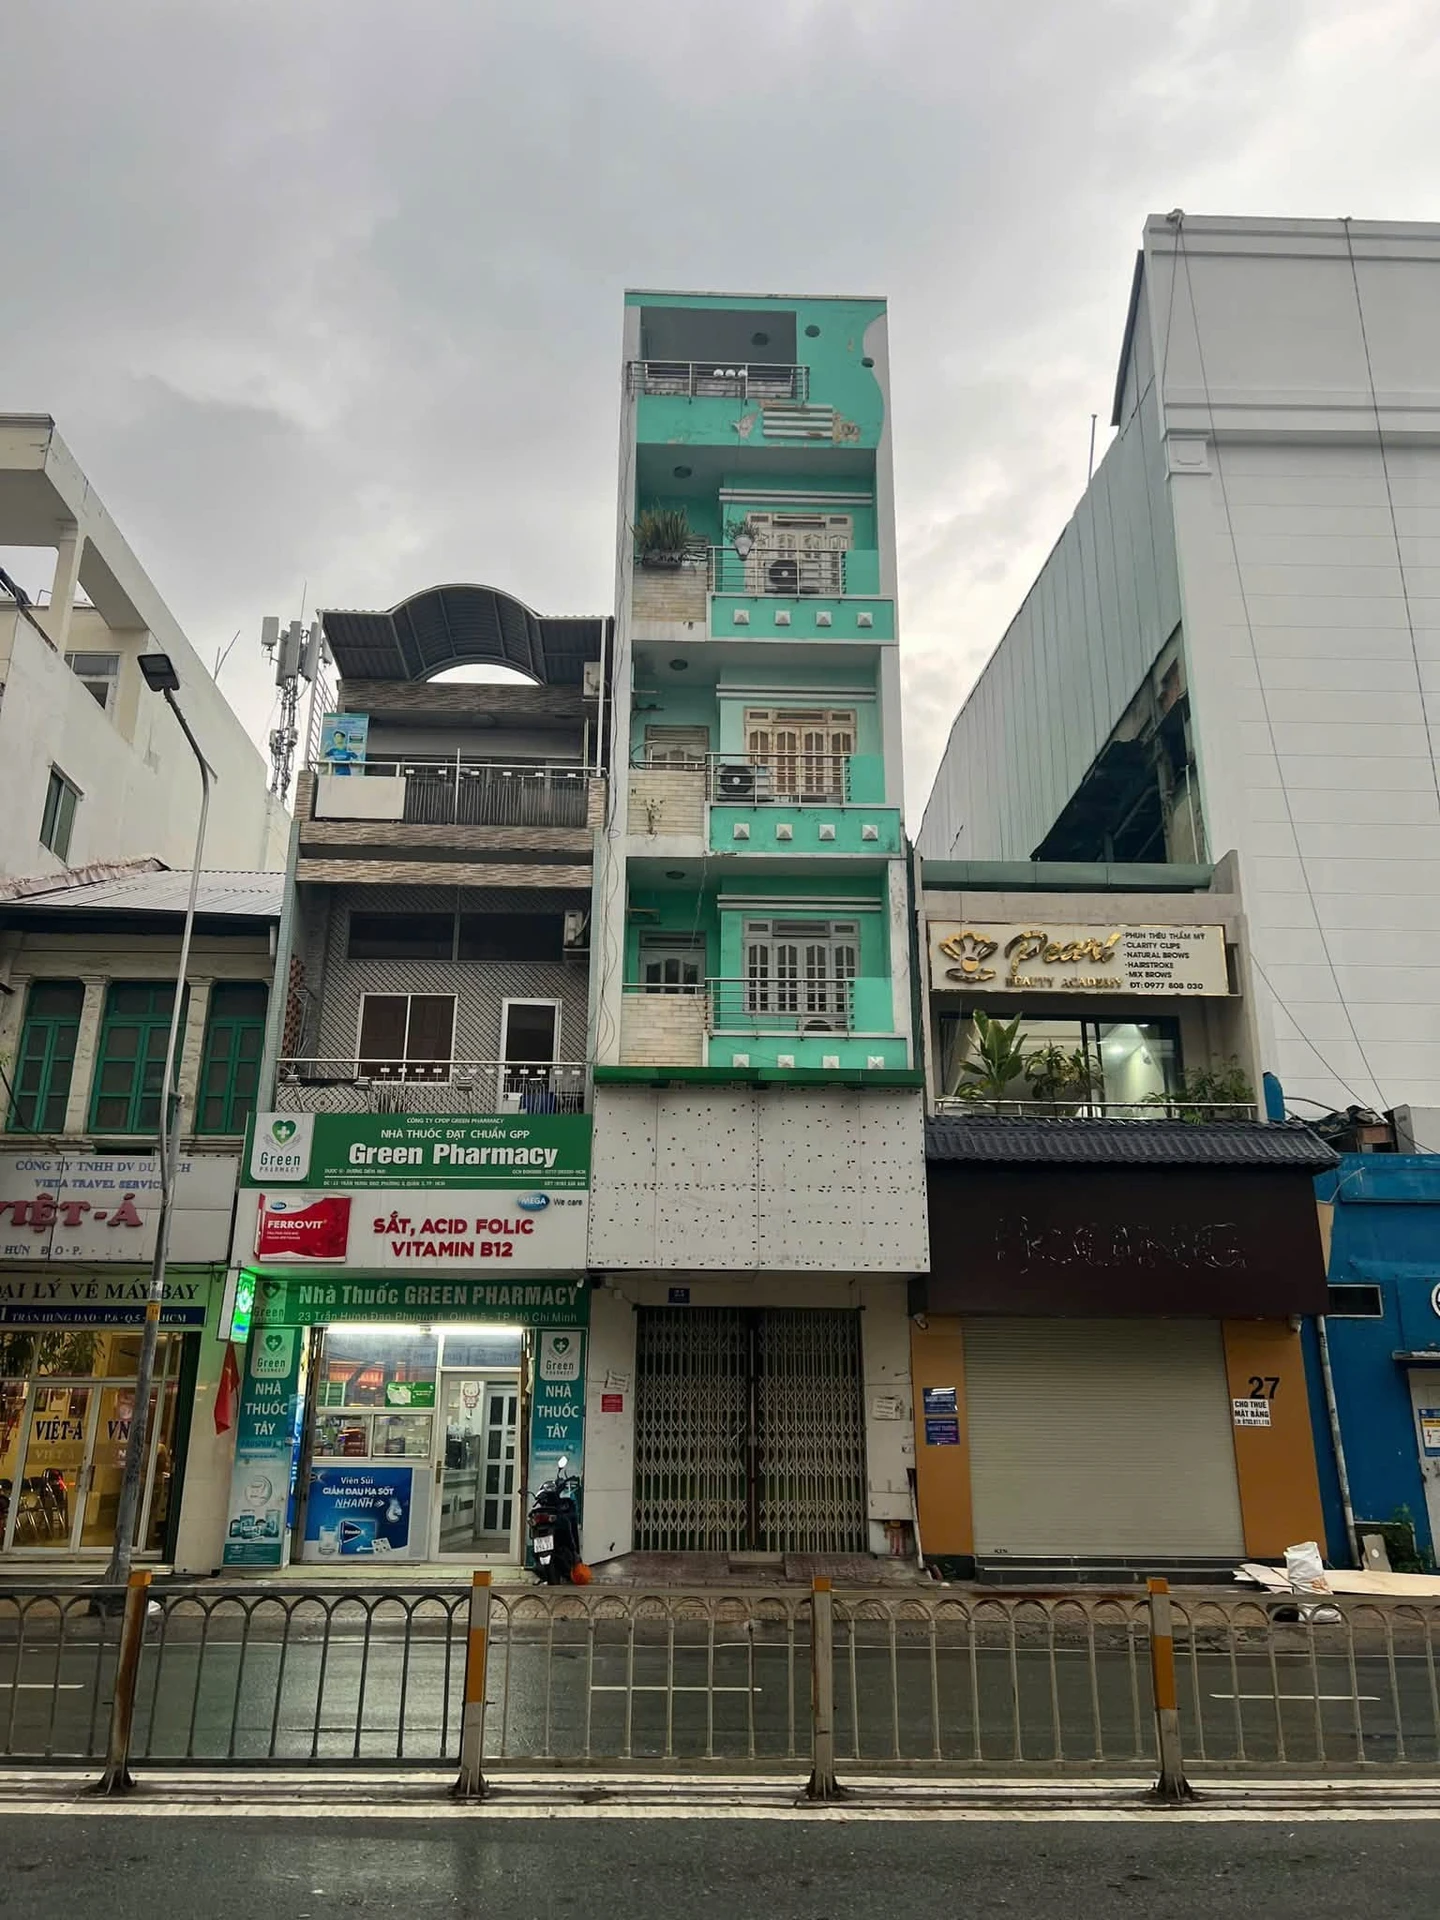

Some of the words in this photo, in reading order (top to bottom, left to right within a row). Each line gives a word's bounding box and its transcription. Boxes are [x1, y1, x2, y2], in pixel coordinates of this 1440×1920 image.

[1005, 930, 1122, 975] Pearl
[1145, 971, 1172, 979] BROWS
[1005, 976, 1055, 989] BEAUTY
[1061, 976, 1124, 989] ACADEMY
[1168, 982, 1184, 990] 808
[407, 1116, 424, 1124] CÔNG
[451, 1117, 470, 1125] GREEN
[381, 1128, 403, 1139] NHÀ
[407, 1127, 442, 1139] THUỐC
[446, 1129, 466, 1141] ĐẠT
[470, 1126, 506, 1139] CHUẨN
[509, 1130, 530, 1139] GPP
[260, 1151, 301, 1166] Green
[349, 1142, 422, 1165] Green
[433, 1143, 558, 1168] Pharmacy
[16, 1159, 50, 1171] CÔNG
[54, 1161, 72, 1171] TY
[77, 1161, 113, 1172] TNHH
[117, 1162, 135, 1172] DV
[138, 1162, 157, 1172] DU
[72, 1180, 115, 1189] TRAVEL
[521, 1197, 547, 1206] MEGA
[554, 1198, 565, 1206] We
[373, 1210, 416, 1237] SẮT,
[420, 1218, 468, 1235] ACID
[476, 1218, 535, 1235] FOLIC
[391, 1241, 475, 1257] VITAMIN
[480, 1241, 513, 1258] B12
[32, 1278, 61, 1299] LÝ
[71, 1279, 99, 1299] VÉ
[105, 1278, 151, 1299] MÁY
[161, 1283, 200, 1299] BAY
[300, 1285, 337, 1305] Nhà
[342, 1282, 399, 1305] Thuốc
[404, 1285, 467, 1305] GREEN
[472, 1285, 578, 1306] PHARMACY
[42, 1310, 72, 1322] HƯNG
[254, 1306, 284, 1317] Green
[298, 1311, 311, 1321] 23
[314, 1310, 337, 1321] Trần
[515, 1311, 529, 1322] Hồ
[552, 1311, 577, 1323] Minh
[257, 1359, 286, 1368] Green
[546, 1360, 574, 1370] Green
[255, 1380, 282, 1395] NHÀ
[546, 1383, 572, 1398] NHÀ
[1248, 1376, 1280, 1399] 27
[245, 1399, 288, 1415] THUỐC
[537, 1402, 579, 1418] THUỐC
[253, 1421, 276, 1436] TÂY
[546, 1423, 568, 1438] TÂY
[322, 1485, 344, 1495] GIẢM
[378, 1485, 395, 1495] SỐT
[334, 1498, 374, 1508] NHANH
